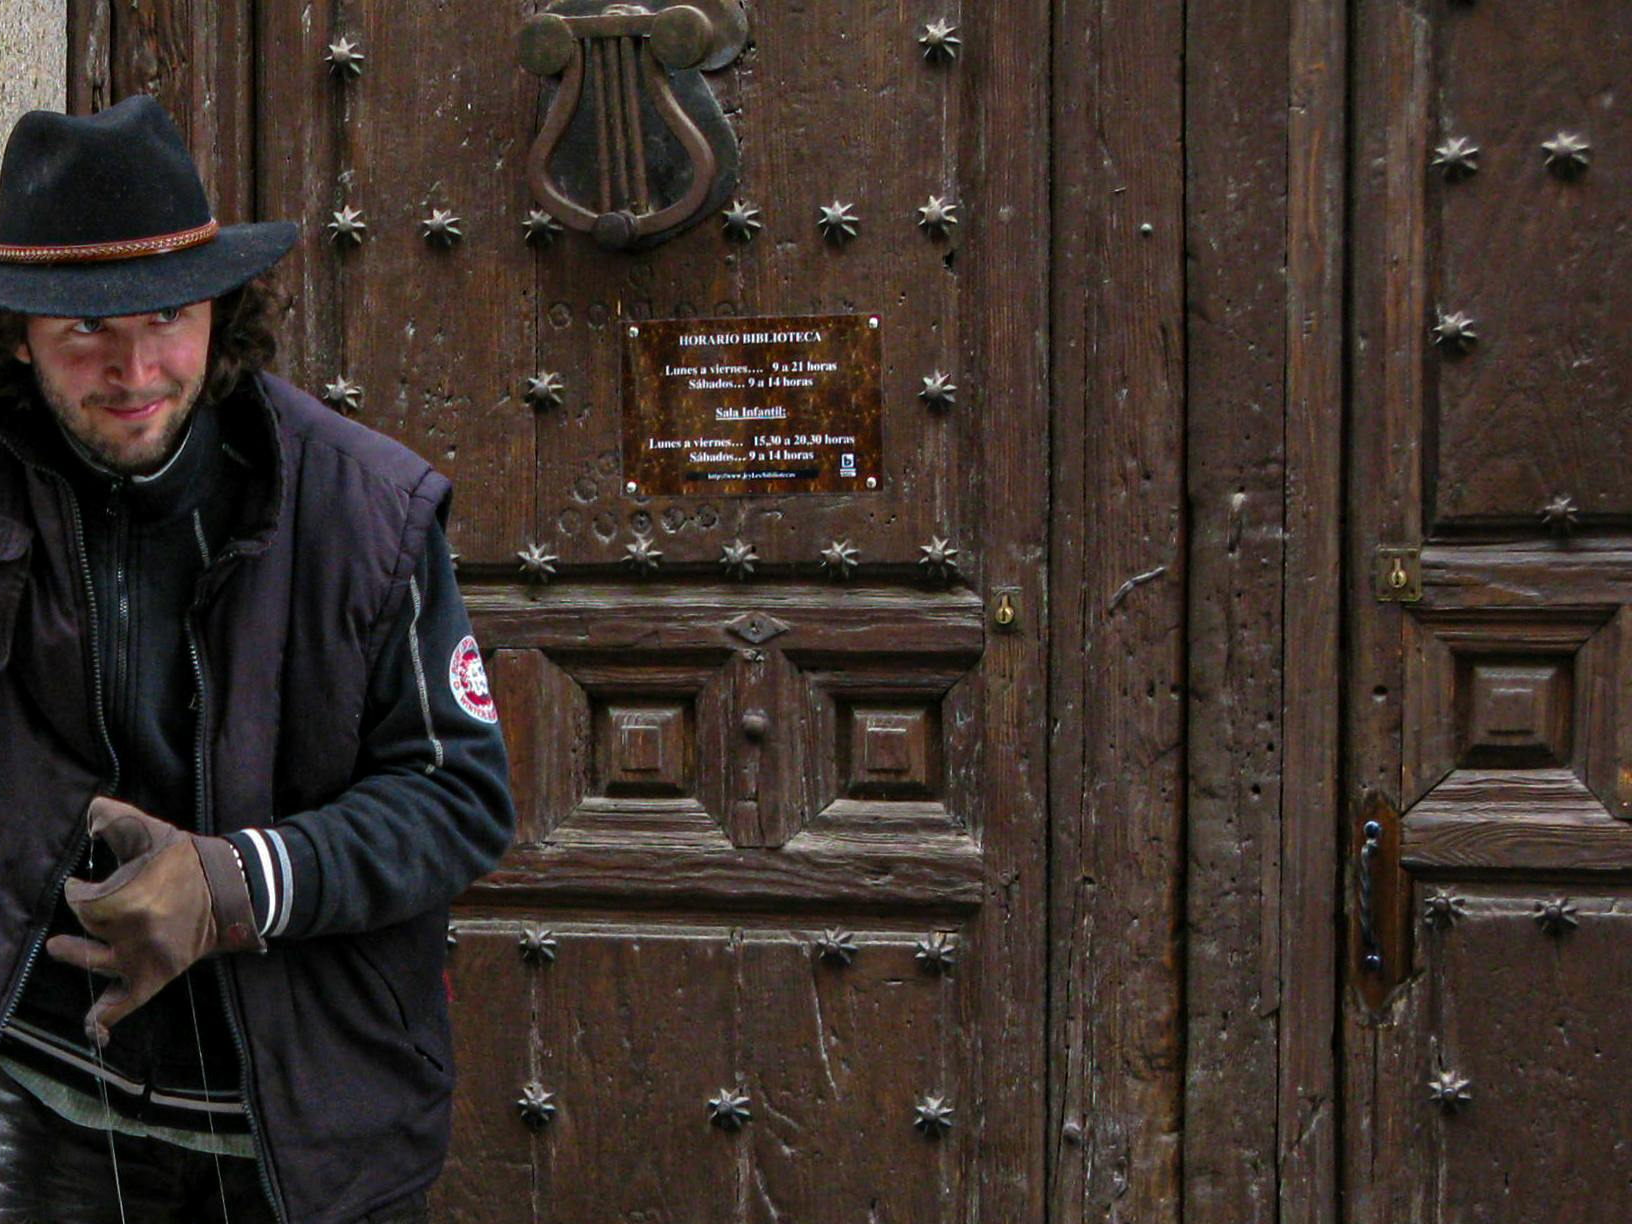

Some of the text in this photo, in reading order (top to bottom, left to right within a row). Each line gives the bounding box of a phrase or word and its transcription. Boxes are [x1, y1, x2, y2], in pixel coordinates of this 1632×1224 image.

[679, 331, 821, 346] HORARIO BIBLIOTECA
[665, 365, 698, 376] Lunes
[700, 366, 707, 375] a
[772, 362, 779, 372] 9
[781, 364, 788, 372] a
[791, 361, 803, 372] 21
[807, 360, 837, 371] horas
[748, 377, 755, 388] 9
[757, 380, 764, 388] a
[768, 376, 780, 387] 14
[783, 376, 813, 387] horas
[715, 405, 787, 419] Sala Infantil:
[649, 438, 682, 449] Lunes
[684, 440, 691, 448] a
[784, 437, 791, 445] a
[824, 433, 855, 444] horas
[749, 451, 756, 461] 9
[758, 453, 765, 461] a
[769, 450, 781, 460] 14
[783, 450, 814, 460] horas
